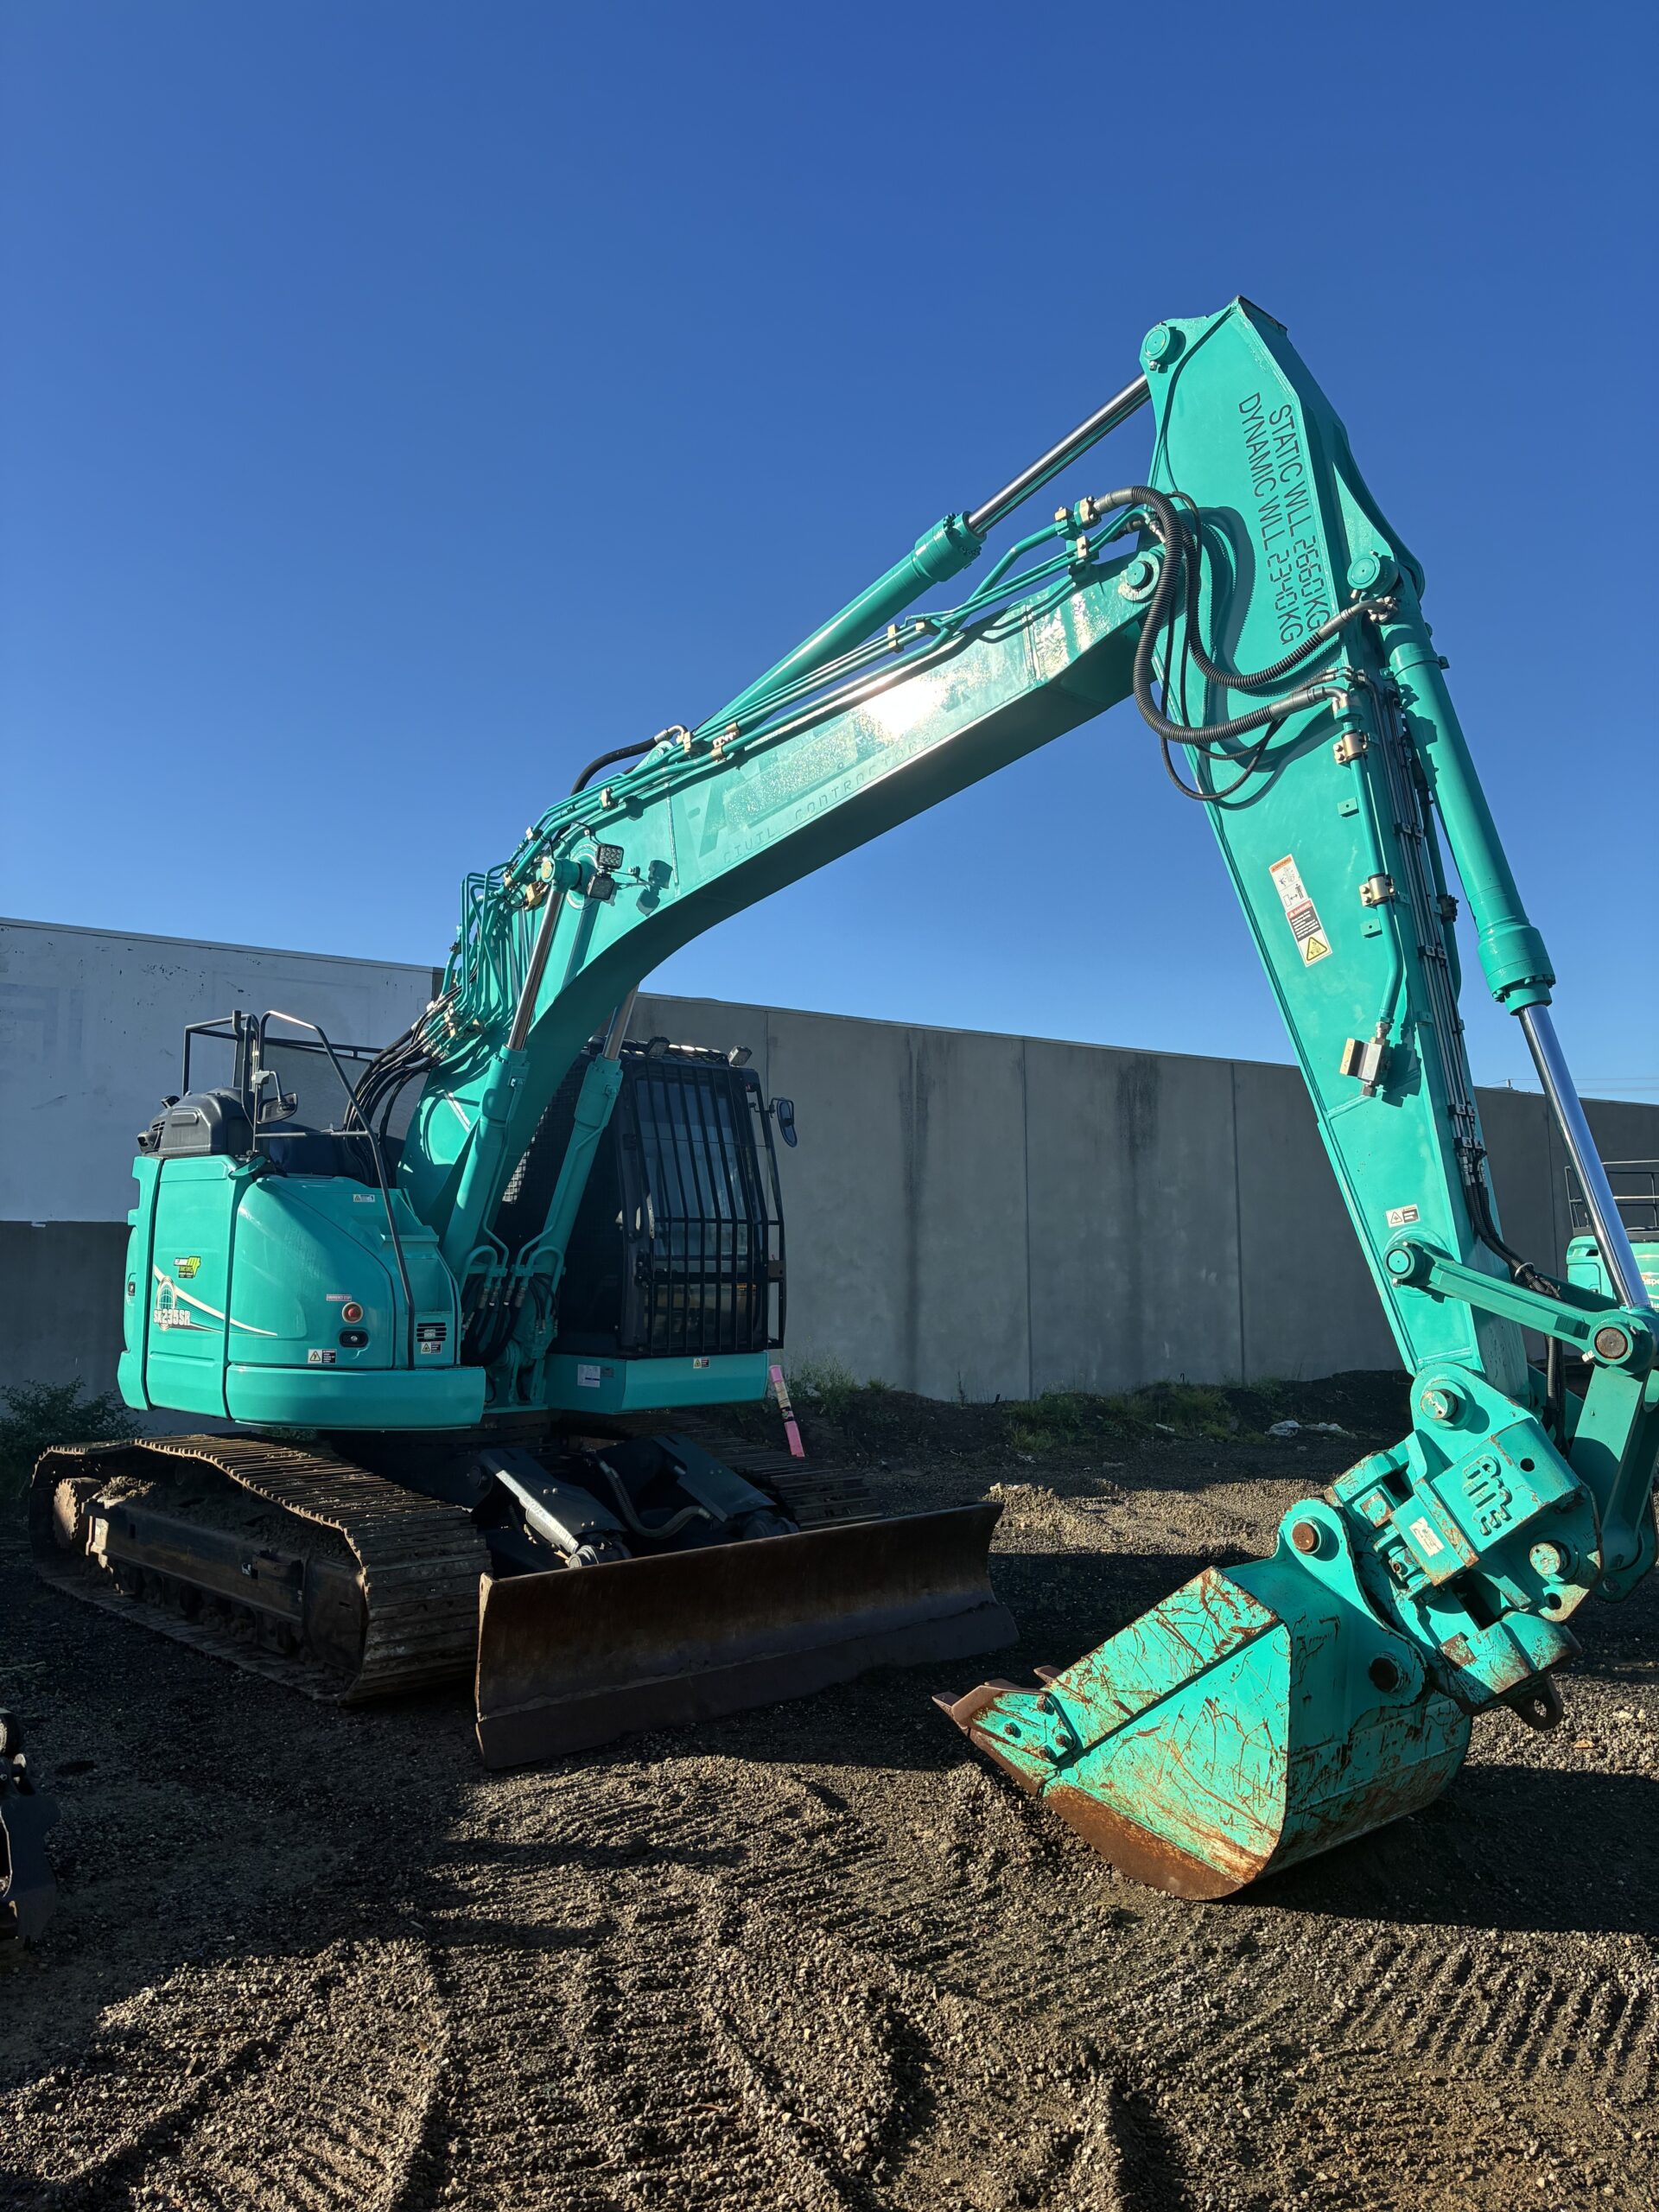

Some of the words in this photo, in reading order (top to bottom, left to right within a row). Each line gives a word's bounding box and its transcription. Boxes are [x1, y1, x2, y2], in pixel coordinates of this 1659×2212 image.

[1238, 391, 1277, 498] DYNAMIC
[1268, 404, 1303, 483] STATIC
[1257, 494, 1286, 551] WLL
[1283, 480, 1312, 537] WLL
[1267, 549, 1304, 645] 2340KG
[1293, 535, 1331, 632] 2660KG
[153, 1307, 192, 1326] SK235SR
